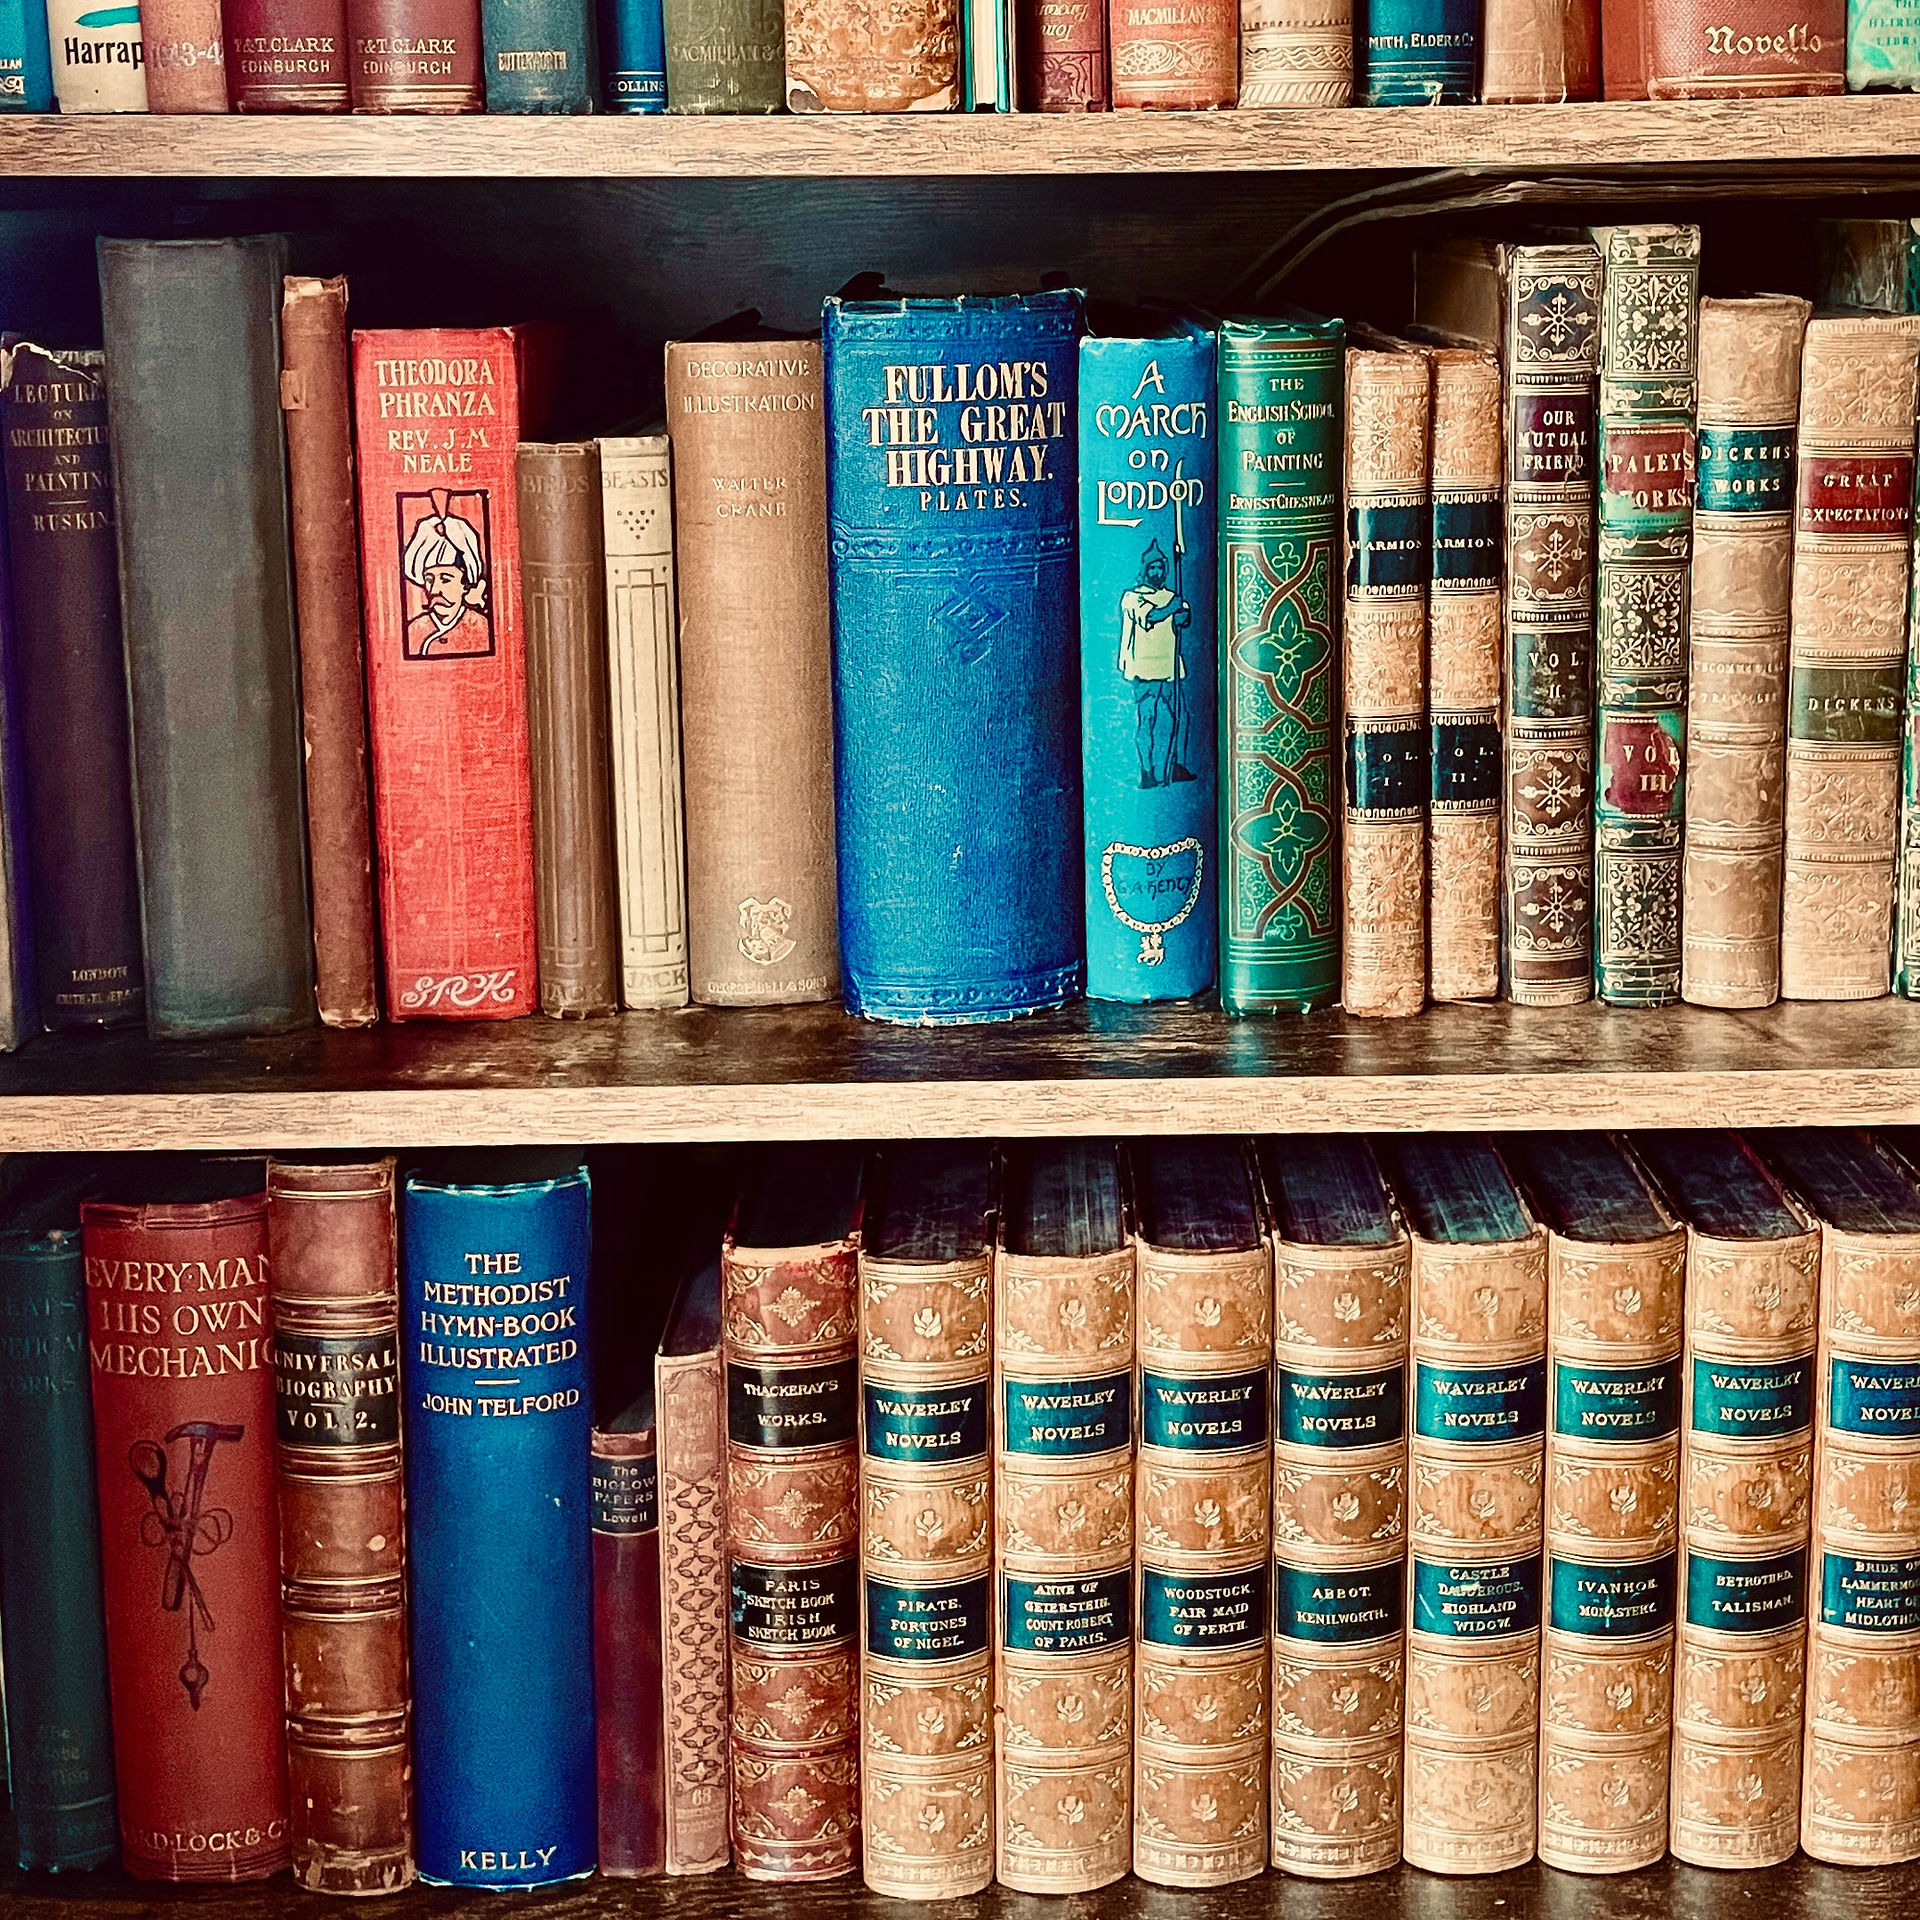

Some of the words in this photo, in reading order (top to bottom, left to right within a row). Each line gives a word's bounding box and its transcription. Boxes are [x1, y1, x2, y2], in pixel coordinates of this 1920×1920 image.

[1704, 23, 1822, 56] Novello
[64, 37, 144, 70] Harrap
[374, 359, 494, 387] THEODORA
[687, 359, 810, 379] DECORATIVE
[882, 361, 1049, 404] FULLOM'S
[1131, 359, 1165, 400] A
[1269, 378, 1305, 392] THE
[378, 391, 496, 418] PHRANZA
[684, 394, 816, 414] ILLUSTRATION
[1228, 400, 1289, 423] ENGLISH
[53, 410, 73, 421] ON
[1543, 410, 1575, 426] OUR
[861, 407, 940, 447] THE
[960, 402, 1067, 443] GREAT
[1276, 429, 1296, 445] OF
[1517, 431, 1587, 448] MUTUAL
[53, 454, 81, 466] AND
[1242, 450, 1324, 472] PAINTING
[1700, 445, 1790, 462] DICKENS
[403, 453, 472, 473] NEALE
[885, 445, 1054, 487] HIGHWAY.
[712, 476, 788, 492] WALTER
[1713, 477, 1781, 495] WORKS
[1823, 473, 1893, 488] GREAT
[920, 488, 1028, 511] PLATES.
[1229, 493, 1277, 511] ERNEST
[716, 502, 787, 518] CRANE
[1801, 507, 1909, 523] EXPECTATIONS
[1807, 696, 1895, 712] DICKENS
[72, 965, 129, 982] LONDON
[464, 1253, 523, 1275] THE
[424, 1275, 571, 1307] METHODIST
[102, 1301, 161, 1335] HIS
[173, 1296, 264, 1336] OWN
[421, 1305, 577, 1339] HYMN-BOOK
[420, 1338, 578, 1370] ILLUSTRATED
[743, 1379, 839, 1398] THACKERAY'S
[1433, 1376, 1529, 1396] WAVERLEY
[1571, 1376, 1666, 1396] WAVERLEY
[1710, 1371, 1802, 1390] WAVERLEY
[1020, 1388, 1116, 1410] WAVERLEY
[1157, 1386, 1253, 1405] WAVERLEY
[1290, 1382, 1387, 1401] WAVERLEY
[422, 1393, 473, 1417] JOHN
[477, 1388, 580, 1417] TELFORD
[875, 1397, 972, 1417] WAVERLEY
[355, 1410, 377, 1430] 2.
[757, 1412, 828, 1428] WORKS.
[1444, 1410, 1519, 1427] NOVELS
[1581, 1410, 1656, 1427] NOVELS
[1720, 1404, 1793, 1421] NOVELS
[1030, 1423, 1106, 1441] NOVELS
[1167, 1420, 1243, 1436] NOVELS
[1301, 1415, 1377, 1432] NOVELS
[885, 1431, 962, 1449] NOVELS
[611, 1465, 639, 1477] The
[594, 1491, 654, 1506] PAPERS
[602, 1511, 648, 1524] Lowell
[1449, 1566, 1510, 1581] CASTLE
[1854, 1560, 1899, 1574] BRIDE
[765, 1579, 821, 1593] PARIS
[1034, 1582, 1077, 1596] ANNE
[1081, 1582, 1099, 1594] OF
[746, 1594, 797, 1610] SKETCH
[801, 1593, 835, 1609] BOOK
[897, 1598, 962, 1611] PIRATE.
[1441, 1600, 1517, 1615] HIGHLAND
[1856, 1595, 1900, 1609] HEART
[1169, 1606, 1207, 1619] FAIR
[1213, 1603, 1249, 1618] MAID
[1295, 1608, 1389, 1626] KENILWORTH.
[765, 1612, 821, 1628] IRISH
[890, 1616, 967, 1633] FORTUNES
[1026, 1617, 1064, 1631] COUNT
[748, 1625, 799, 1641] SKETCH
[802, 1623, 837, 1640] BOOK
[1173, 1624, 1192, 1636] OF
[893, 1637, 913, 1649] OF
[1034, 1636, 1053, 1648] OF
[1059, 1632, 1108, 1648] PARIS.
[459, 1845, 557, 1871] KELLY
